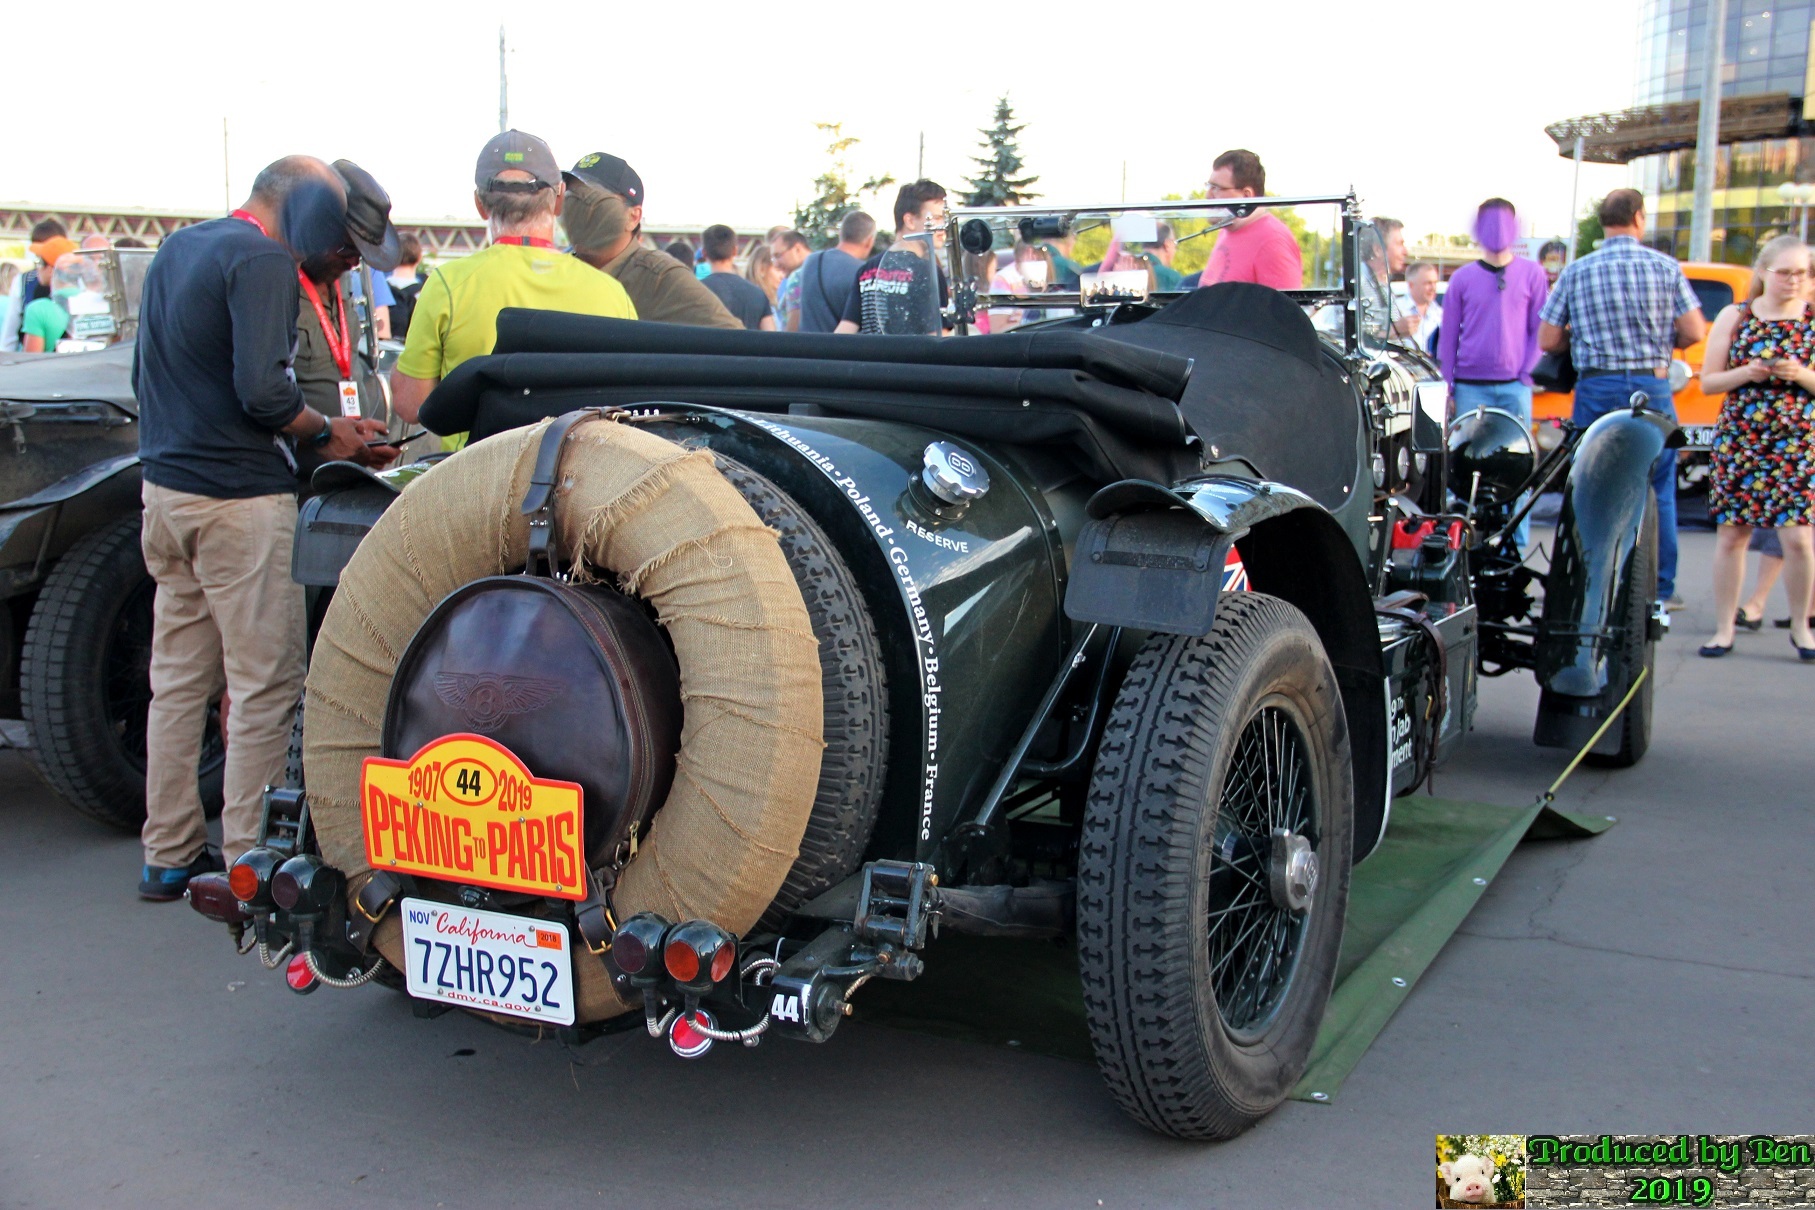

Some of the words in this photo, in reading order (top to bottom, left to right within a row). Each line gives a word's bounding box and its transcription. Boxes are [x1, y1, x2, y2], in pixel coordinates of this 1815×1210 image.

[752, 419, 835, 473] Lithuania
[836, 476, 894, 539] Poland
[906, 520, 969, 554] RESERVE
[889, 546, 934, 645] Germany
[924, 656, 942, 752] Belgium
[408, 761, 441, 802] 1907
[456, 768, 481, 797] 44
[498, 769, 532, 812] 2019
[921, 763, 938, 841] France
[369, 783, 474, 872] PEKING
[472, 836, 486, 860] TO
[486, 810, 577, 888] PARIS
[409, 910, 430, 925] NOV
[436, 912, 538, 948] California
[414, 937, 560, 1009] 7ZHR952
[447, 991, 531, 1012] dmv.ca.gov
[771, 993, 799, 1023] 44
